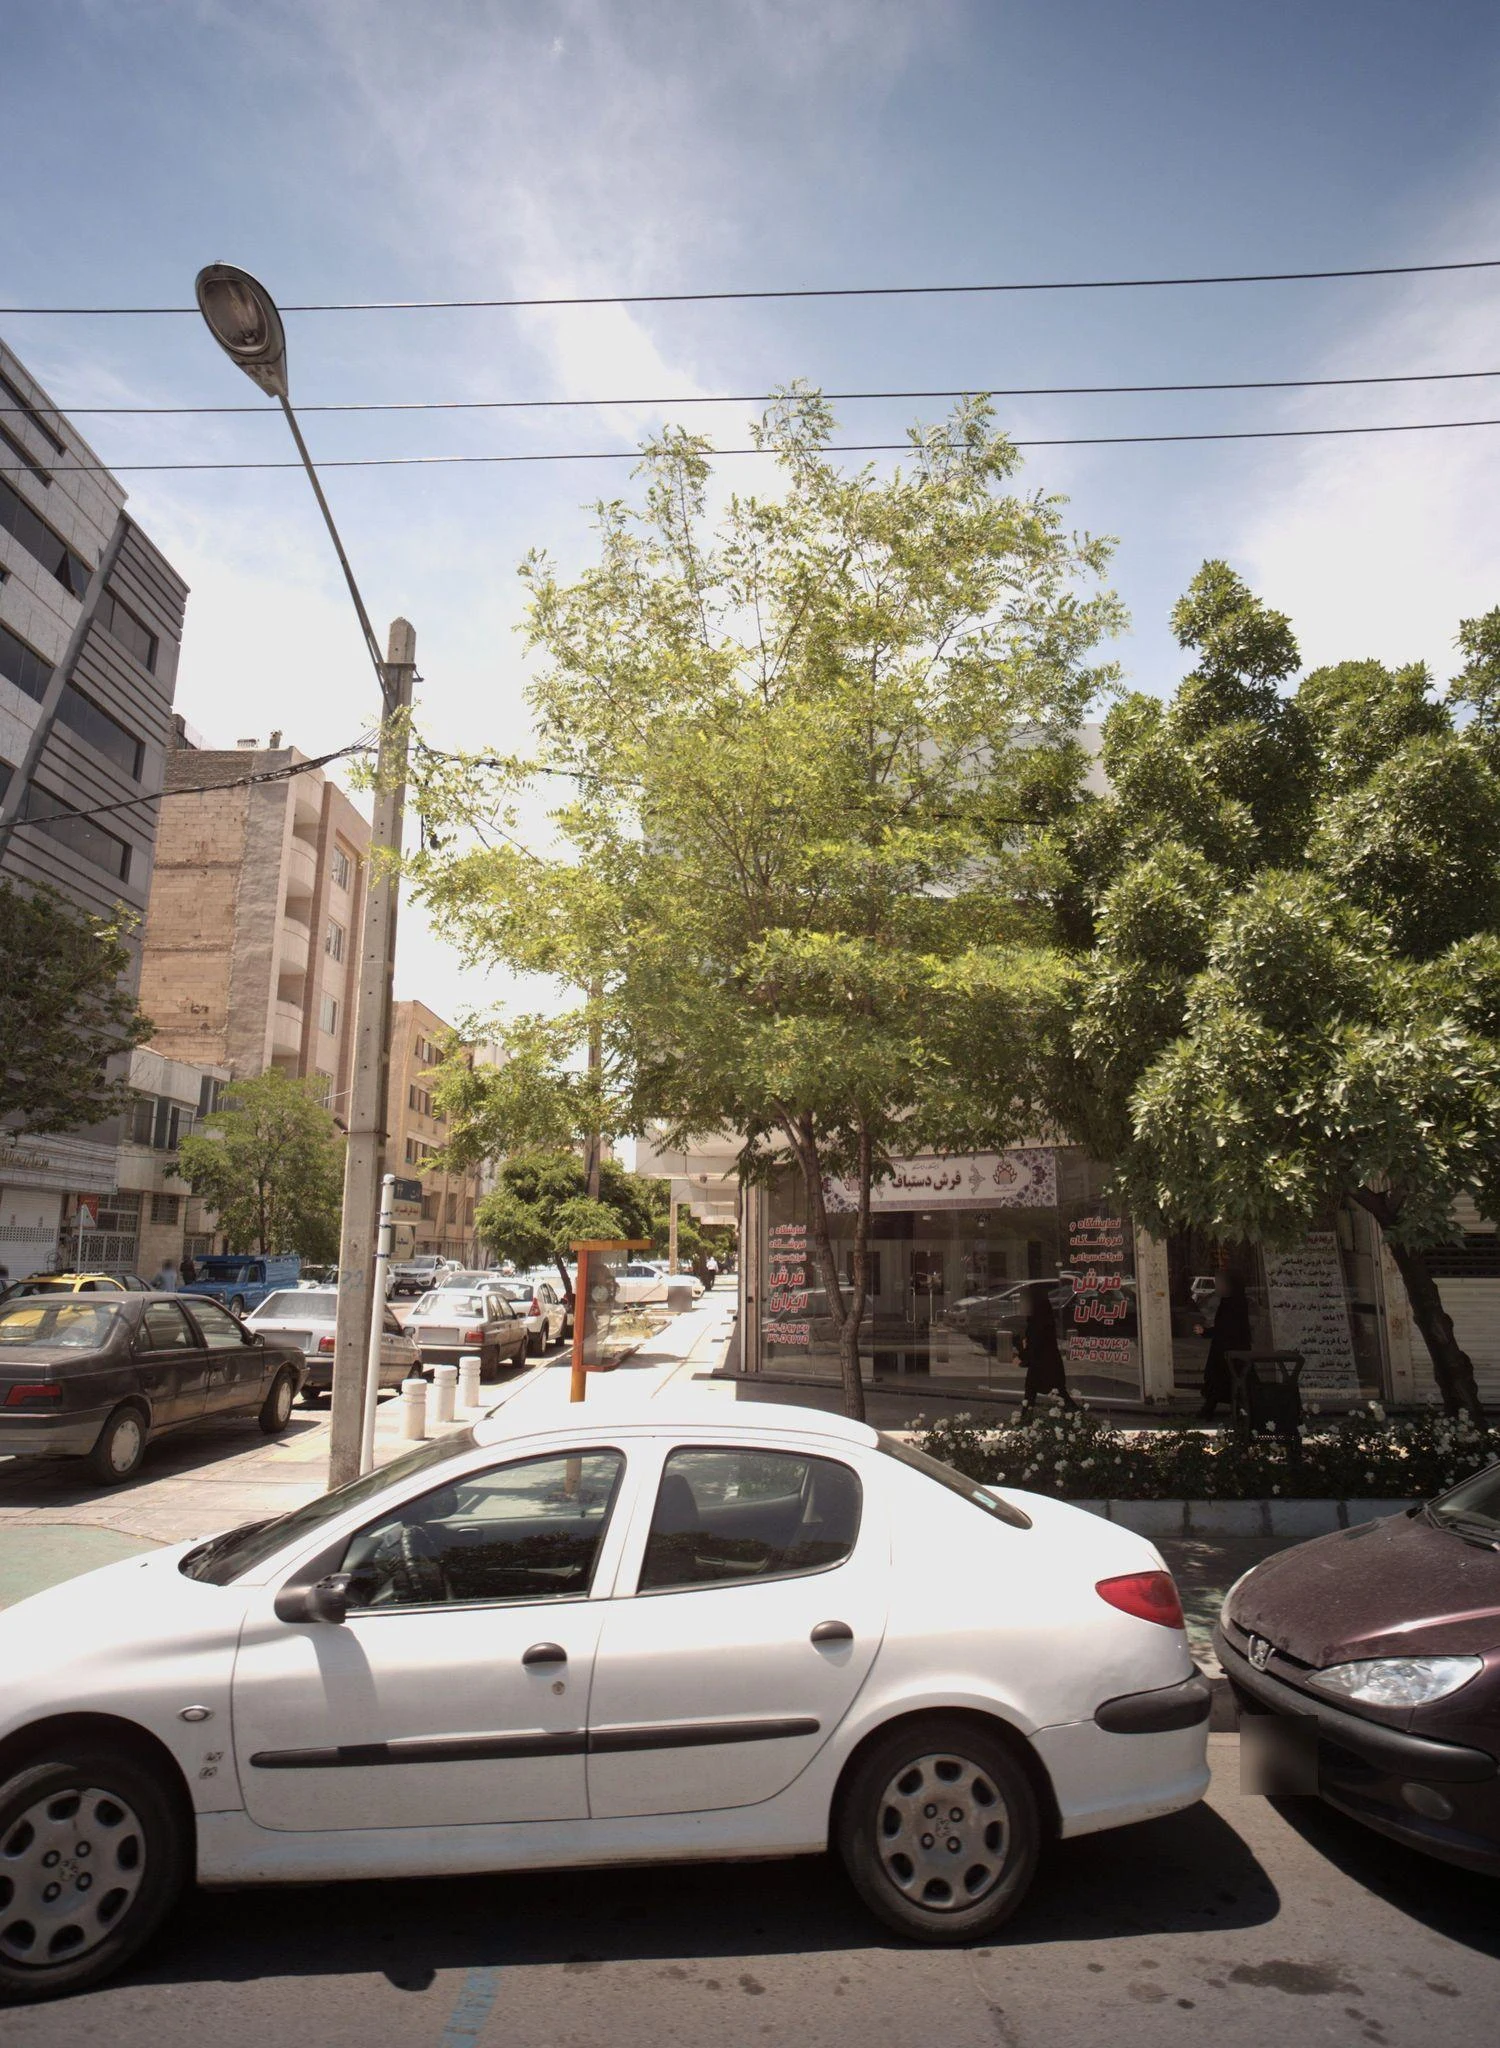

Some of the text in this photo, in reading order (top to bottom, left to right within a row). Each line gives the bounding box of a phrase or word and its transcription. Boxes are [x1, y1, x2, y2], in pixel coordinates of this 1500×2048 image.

[892, 1170, 962, 1191] فرش دستباف
[1069, 1216, 1121, 1232] نمایشگاه و
[1070, 1234, 1123, 1247] فروشگاه
[1070, 1252, 1124, 1264] شرکت سهامی
[770, 1264, 805, 1288] فرش
[1072, 1268, 1121, 1294] فرش
[770, 1292, 808, 1313] ایران
[1074, 1300, 1127, 1325] ایران
